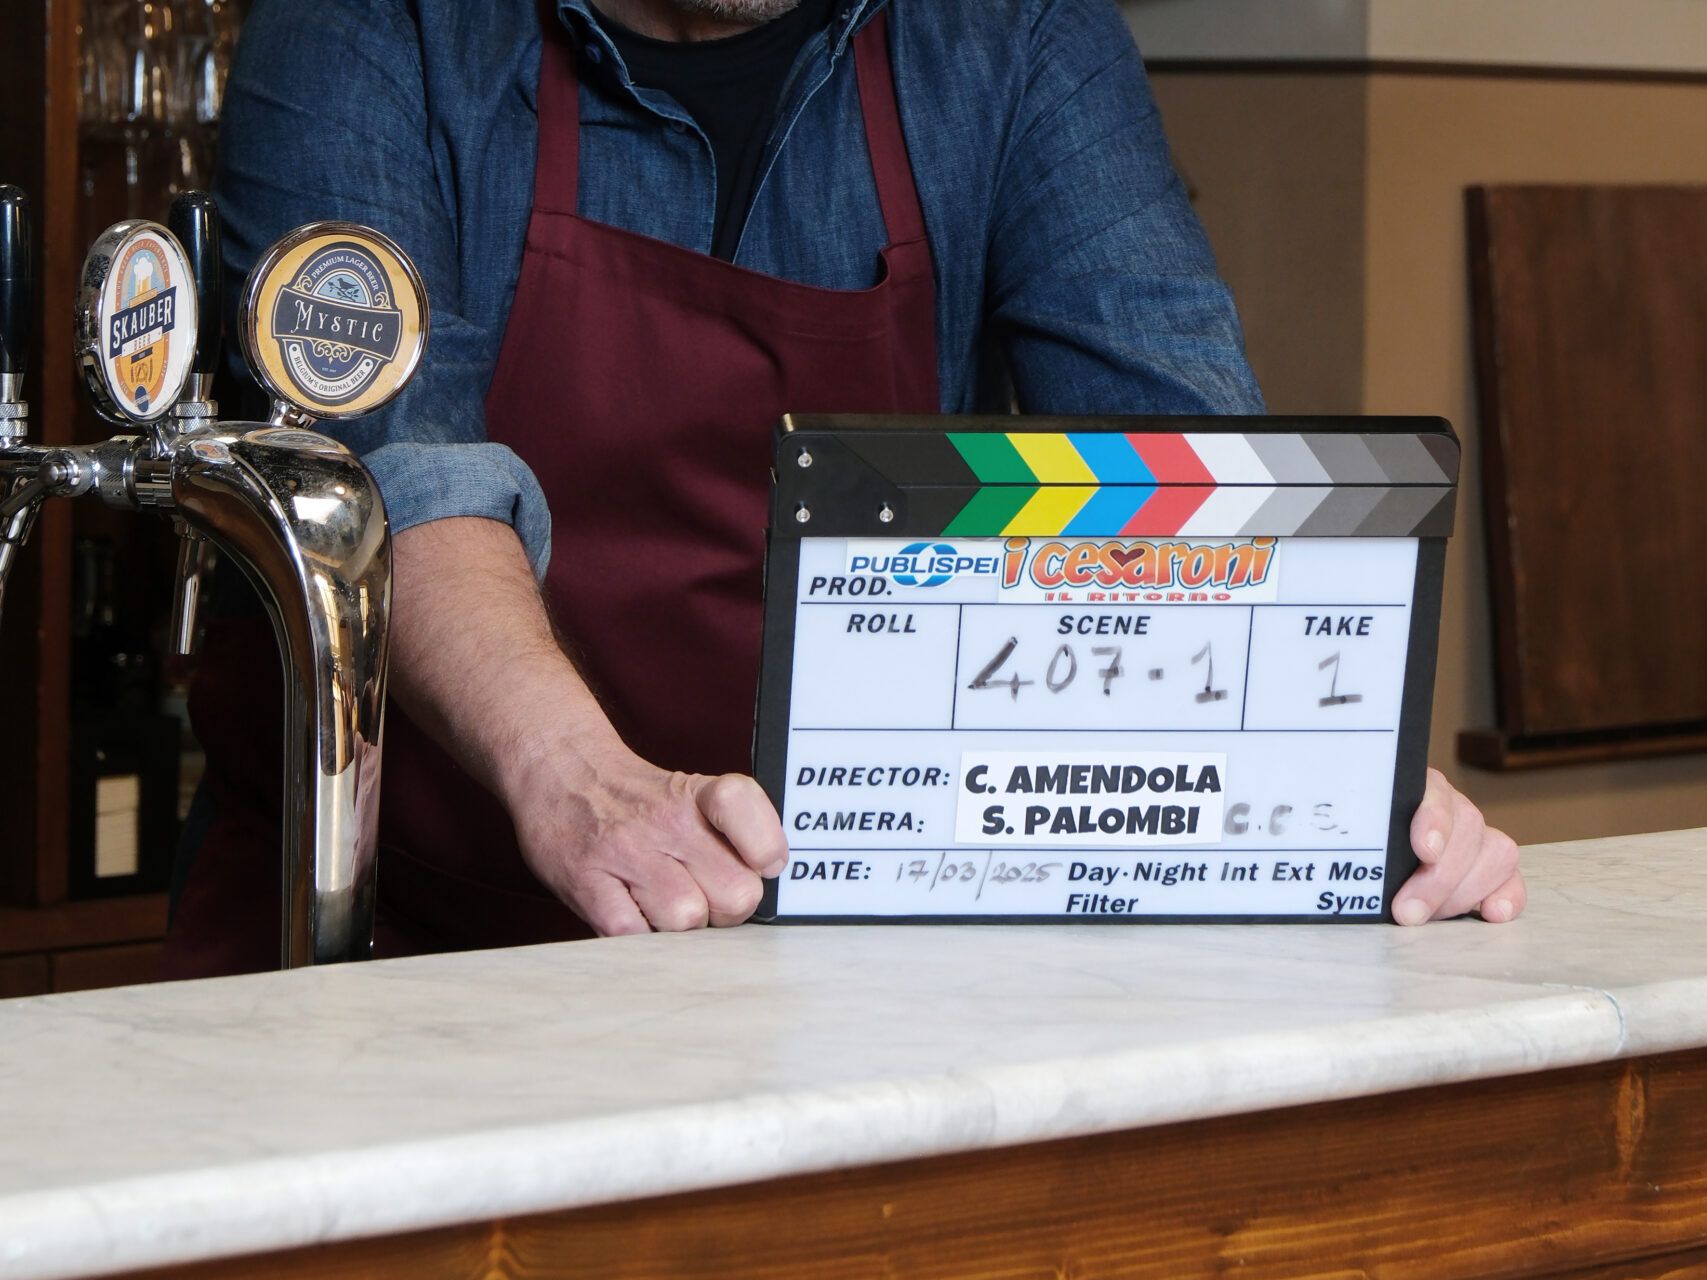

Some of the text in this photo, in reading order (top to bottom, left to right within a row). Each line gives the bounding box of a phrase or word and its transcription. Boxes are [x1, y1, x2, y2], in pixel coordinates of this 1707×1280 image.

[311, 255, 380, 291] PREMIUM LAGER BEER
[112, 295, 172, 349] SKAUBER
[290, 299, 383, 342] MYSTIC
[293, 356, 365, 392] BELGIUM'S ORIGINAL BEER
[850, 556, 1000, 574] PUBLISPEI
[1028, 536, 1278, 592] cesaroni
[808, 577, 893, 597] PROD.
[1044, 592, 1067, 602] IL
[846, 614, 917, 634] ROLL
[1057, 615, 1151, 635] SCENE
[1304, 616, 1374, 636] TAKE
[1318, 650, 1363, 708] 1
[796, 764, 1222, 795] DIRECTOR: C. AMENDOLA
[794, 805, 1201, 836] CAMERA: S. PALOMBI
[790, 861, 872, 881] DATE:
[896, 850, 1063, 902] 17/03/2025
[1220, 862, 1259, 882] Int
[1272, 862, 1315, 882] Ext
[1328, 862, 1383, 882] Mos
[1066, 891, 1381, 915] Filter Sync
